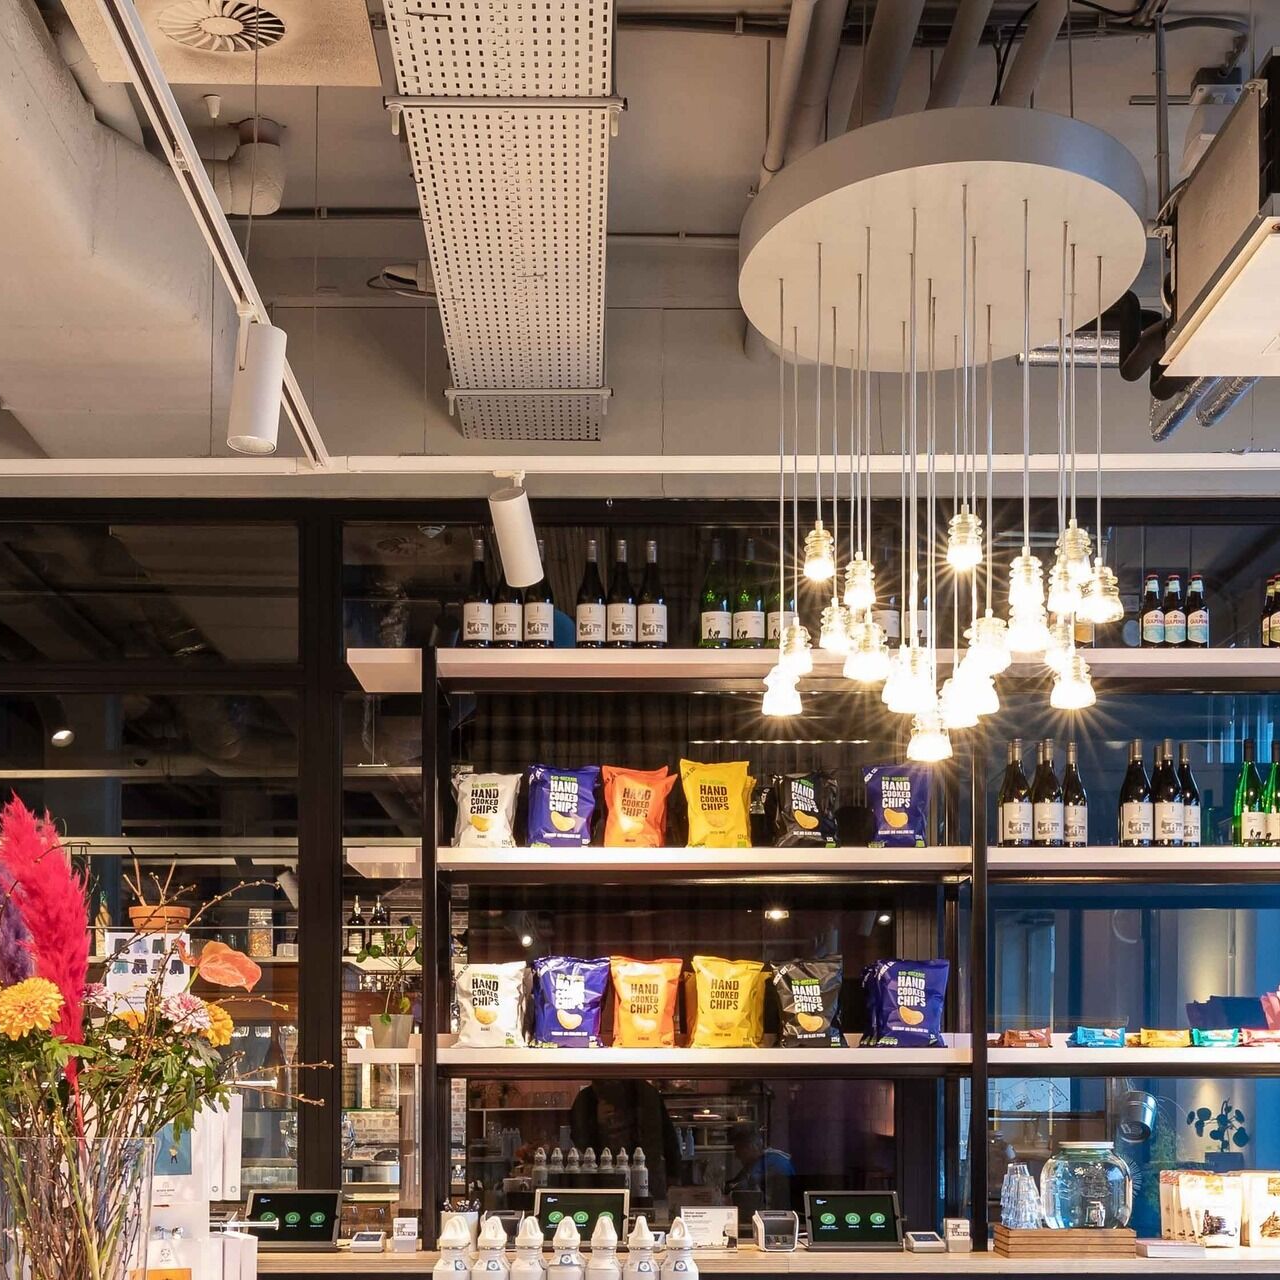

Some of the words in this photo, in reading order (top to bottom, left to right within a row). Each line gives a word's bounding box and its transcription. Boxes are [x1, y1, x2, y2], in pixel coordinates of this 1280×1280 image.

[550, 782, 578, 794] HAND
[699, 785, 727, 796] HAND
[791, 781, 814, 799] HAND
[881, 781, 911, 791] HAND
[470, 788, 499, 799] HAND
[549, 793, 578, 802] COOKED
[882, 790, 911, 798] COOKED
[470, 798, 499, 806] COOKED
[621, 799, 649, 808] COOKED
[701, 803, 729, 811] CHIPS
[792, 800, 819, 813] CHIPS
[882, 798, 911, 808] CHIPS
[470, 805, 498, 814] CHIPS
[549, 802, 578, 813] CHIPS
[621, 807, 648, 818] CHIPS
[472, 978, 499, 991] HAND
[711, 979, 739, 991] HAND
[897, 976, 926, 990] HAND
[472, 990, 498, 998] COOKED
[631, 984, 659, 995] HAND
[791, 985, 820, 996] HAND
[897, 987, 925, 998] COOKED
[630, 995, 659, 1004] COOKED
[710, 990, 739, 1000] COOKED
[793, 995, 822, 1003] COOKED
[472, 997, 499, 1006] CHIPS
[710, 999, 739, 1010] CHIPS
[897, 996, 926, 1007] CHIPS
[630, 1004, 658, 1014] CHIPS
[794, 1003, 823, 1013] CHIPS
